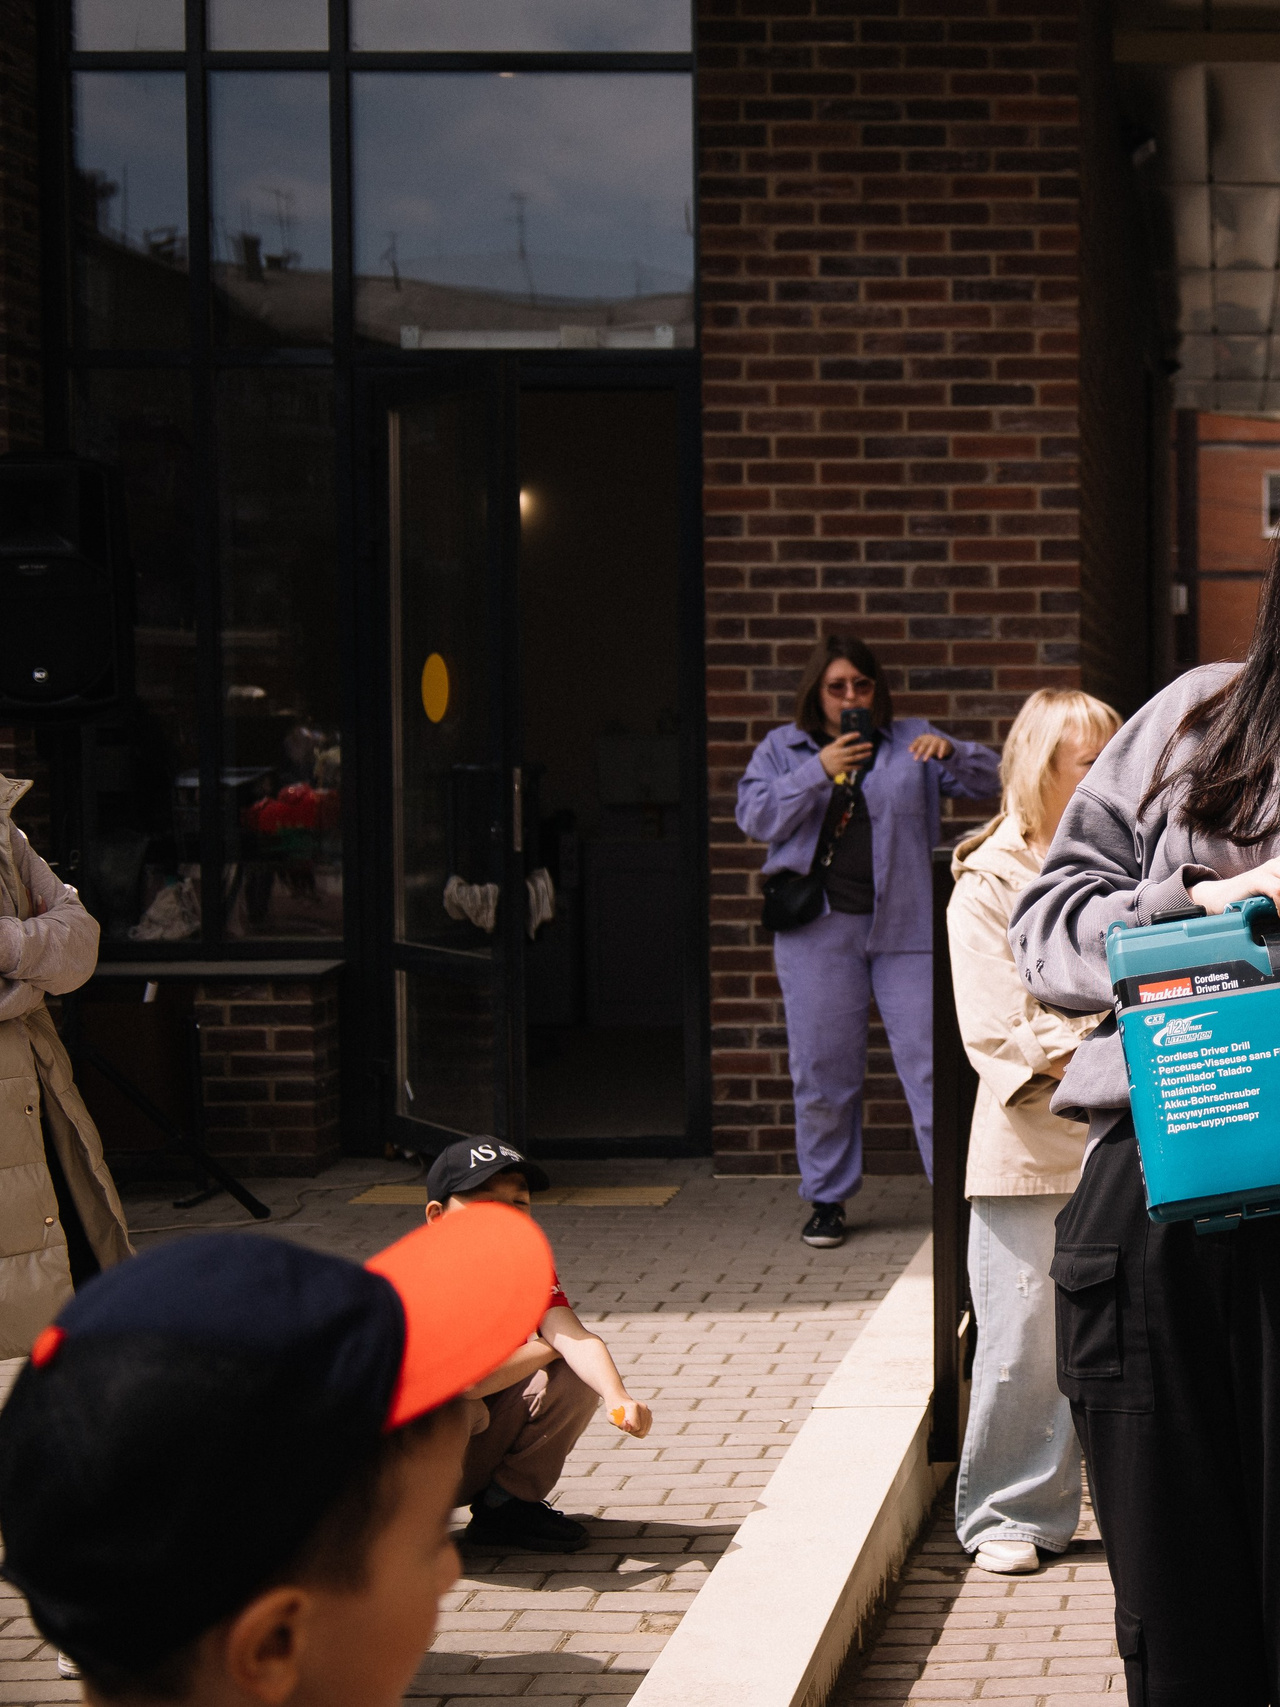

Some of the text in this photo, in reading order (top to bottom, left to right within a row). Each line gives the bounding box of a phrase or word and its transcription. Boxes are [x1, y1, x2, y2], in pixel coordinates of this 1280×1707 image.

[1194, 972, 1230, 985] Cordless
[1196, 980, 1239, 995] Driver Drill
[1156, 1041, 1251, 1064] Cordless Driver Drill
[1158, 1055, 1247, 1076] Perceuse-Visseuse
[1249, 1050, 1271, 1061] sans
[1160, 1065, 1252, 1087] Atornillador Taladro
[1161, 1082, 1217, 1099] Inalámbrico
[1164, 1087, 1260, 1110] Akku-Bohrschrauber
[1166, 1101, 1250, 1122] Аккумуляторная
[1167, 1111, 1260, 1135] Дрель-шуруповерт
